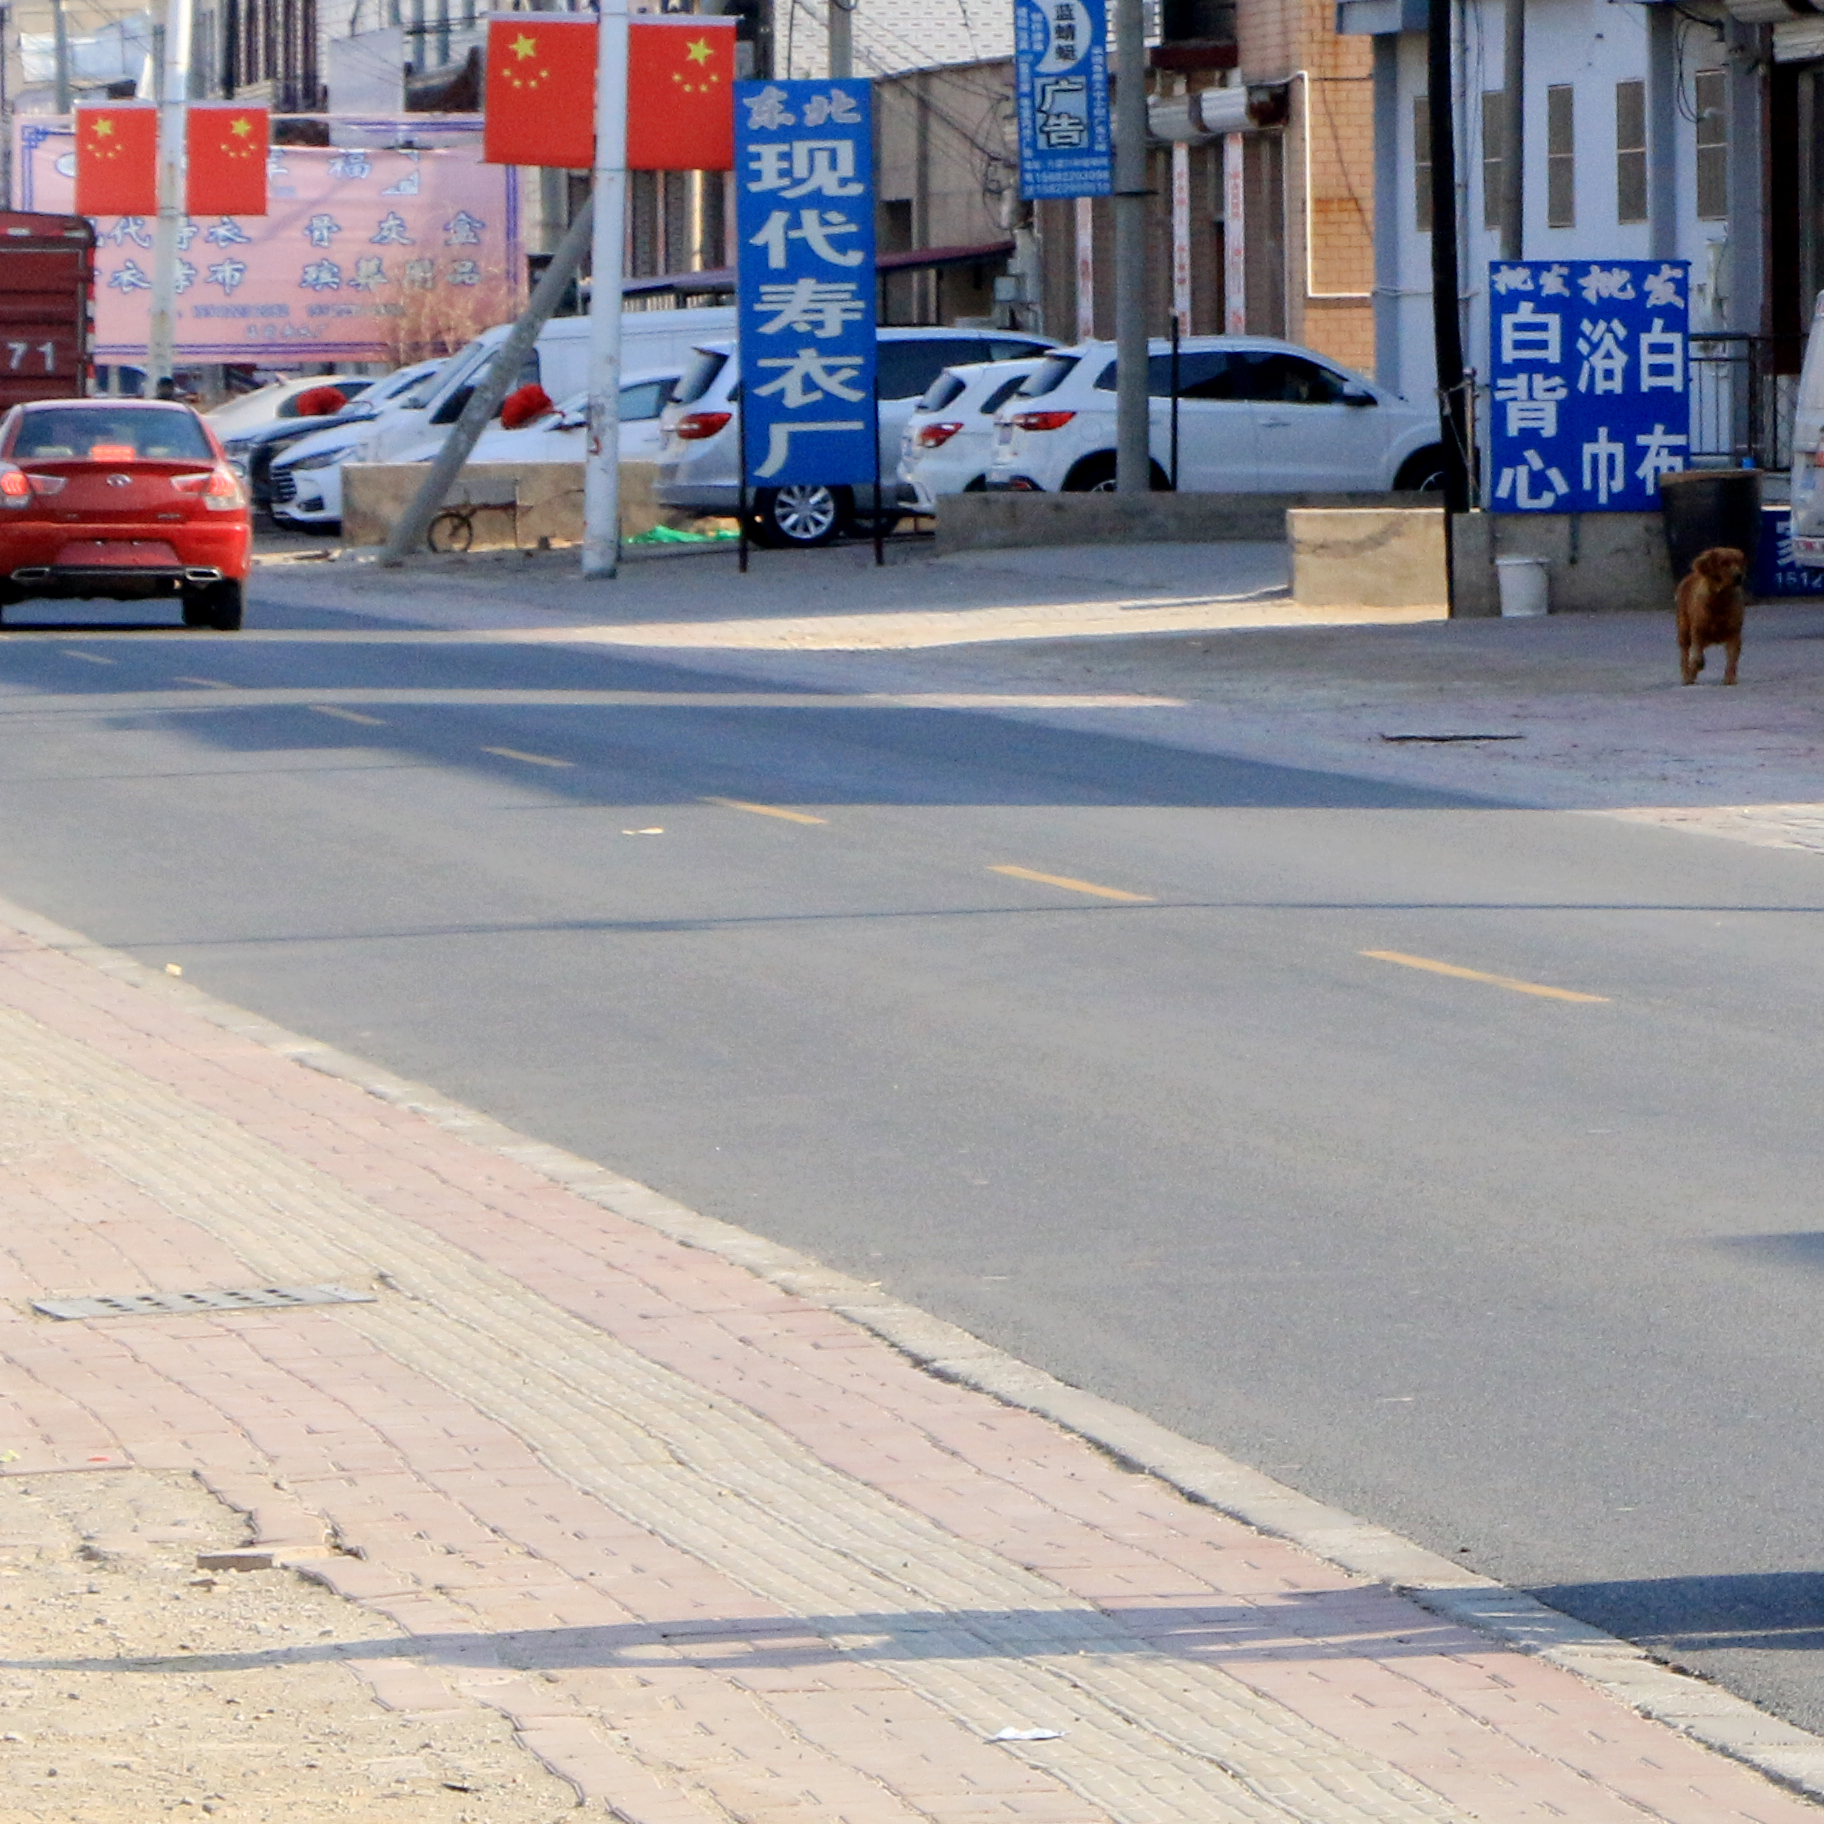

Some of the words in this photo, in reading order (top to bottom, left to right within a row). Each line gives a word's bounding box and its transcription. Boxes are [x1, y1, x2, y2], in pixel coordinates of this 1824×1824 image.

[743, 86, 862, 132] 东北
[1038, 77, 1085, 147] 广告
[747, 139, 866, 478] 现代寿衣厂
[1492, 264, 1569, 297] 批发
[1577, 262, 1686, 310] 批发
[7, 341, 55, 372] 71
[1495, 301, 1570, 510] 白背心
[1577, 316, 1629, 505] 浴巾
[1636, 316, 1688, 497] 白布
